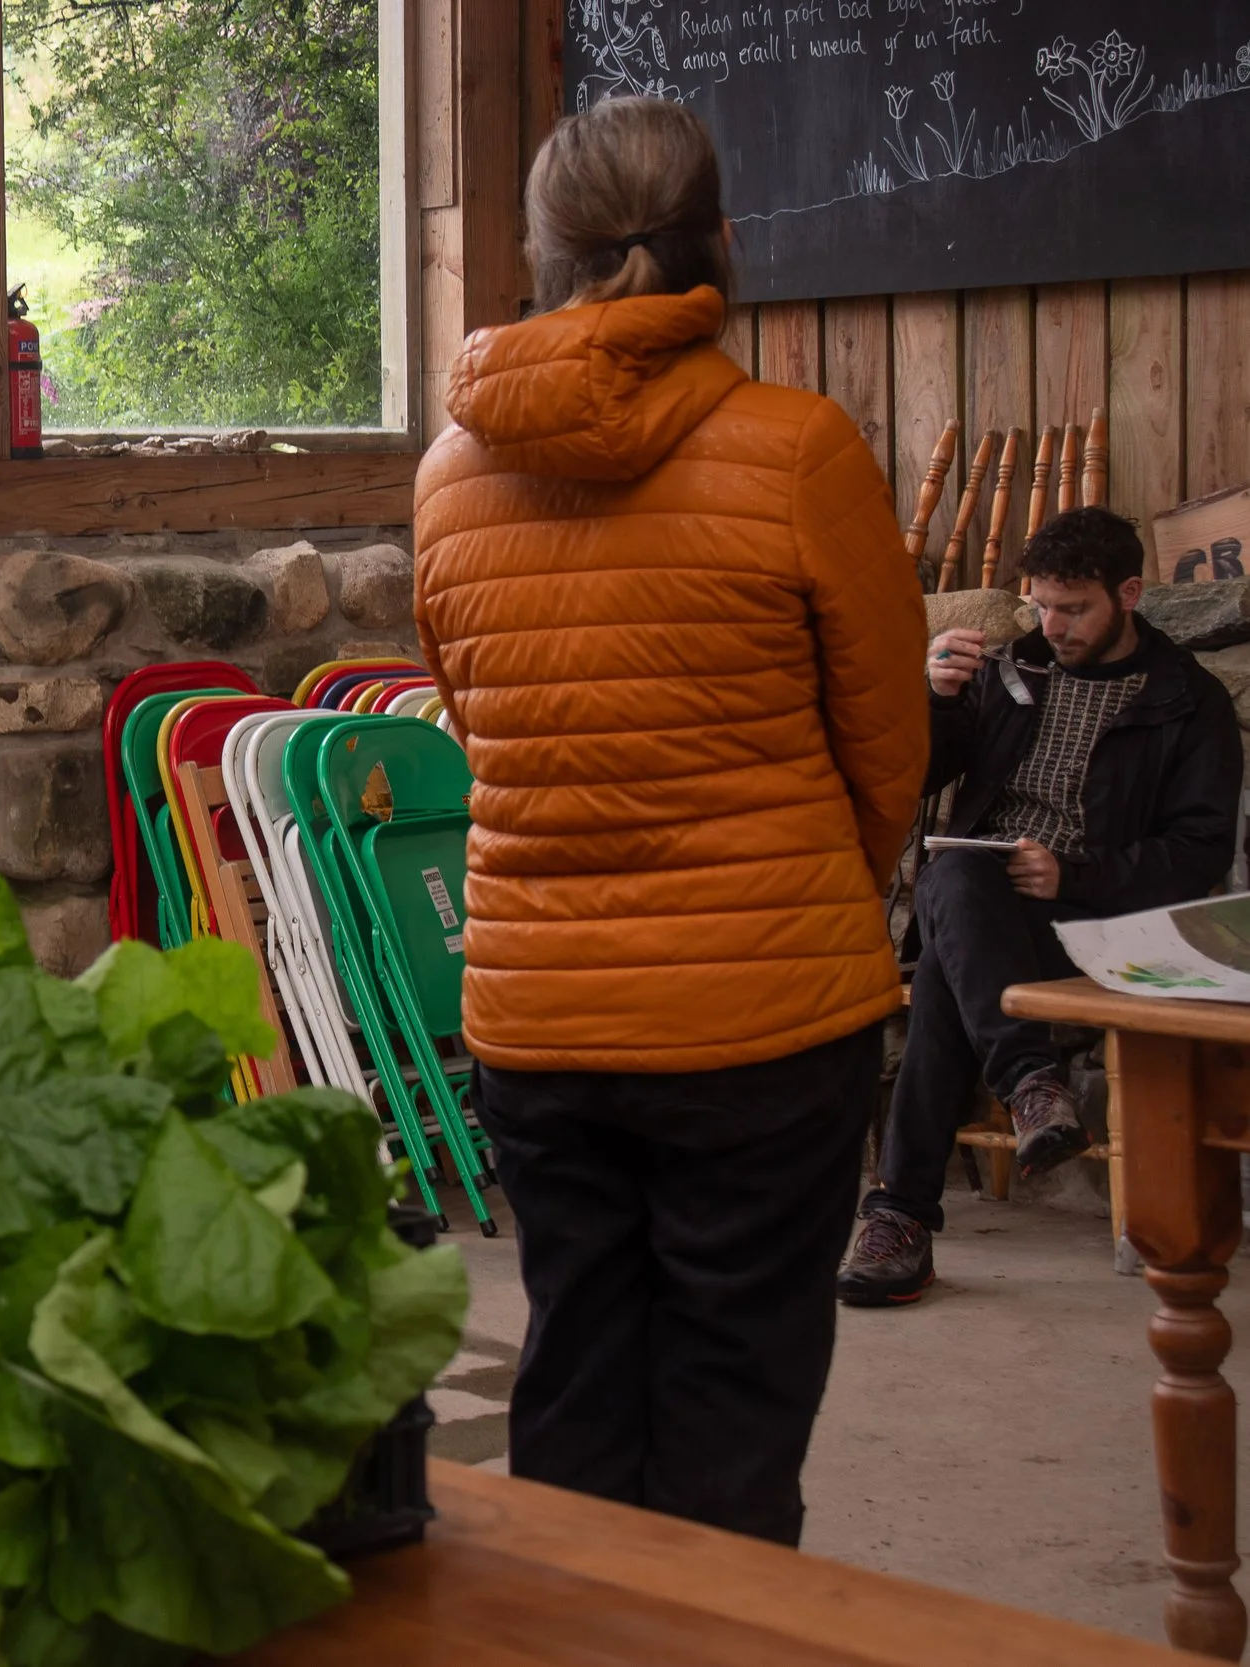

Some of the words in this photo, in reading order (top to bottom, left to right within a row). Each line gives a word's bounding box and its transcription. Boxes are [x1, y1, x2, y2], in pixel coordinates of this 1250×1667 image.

[681, 10, 732, 48] Rydan
[742, 4, 773, 28] ni'n
[784, 0, 825, 39] profi
[838, 0, 872, 18] bod
[682, 50, 729, 83] annog
[738, 33, 782, 65] eraill
[791, 36, 798, 61] i
[809, 29, 867, 58] wneud
[884, 30, 904, 66] yr
[915, 30, 938, 49] un
[946, 16, 1001, 55] fath.
